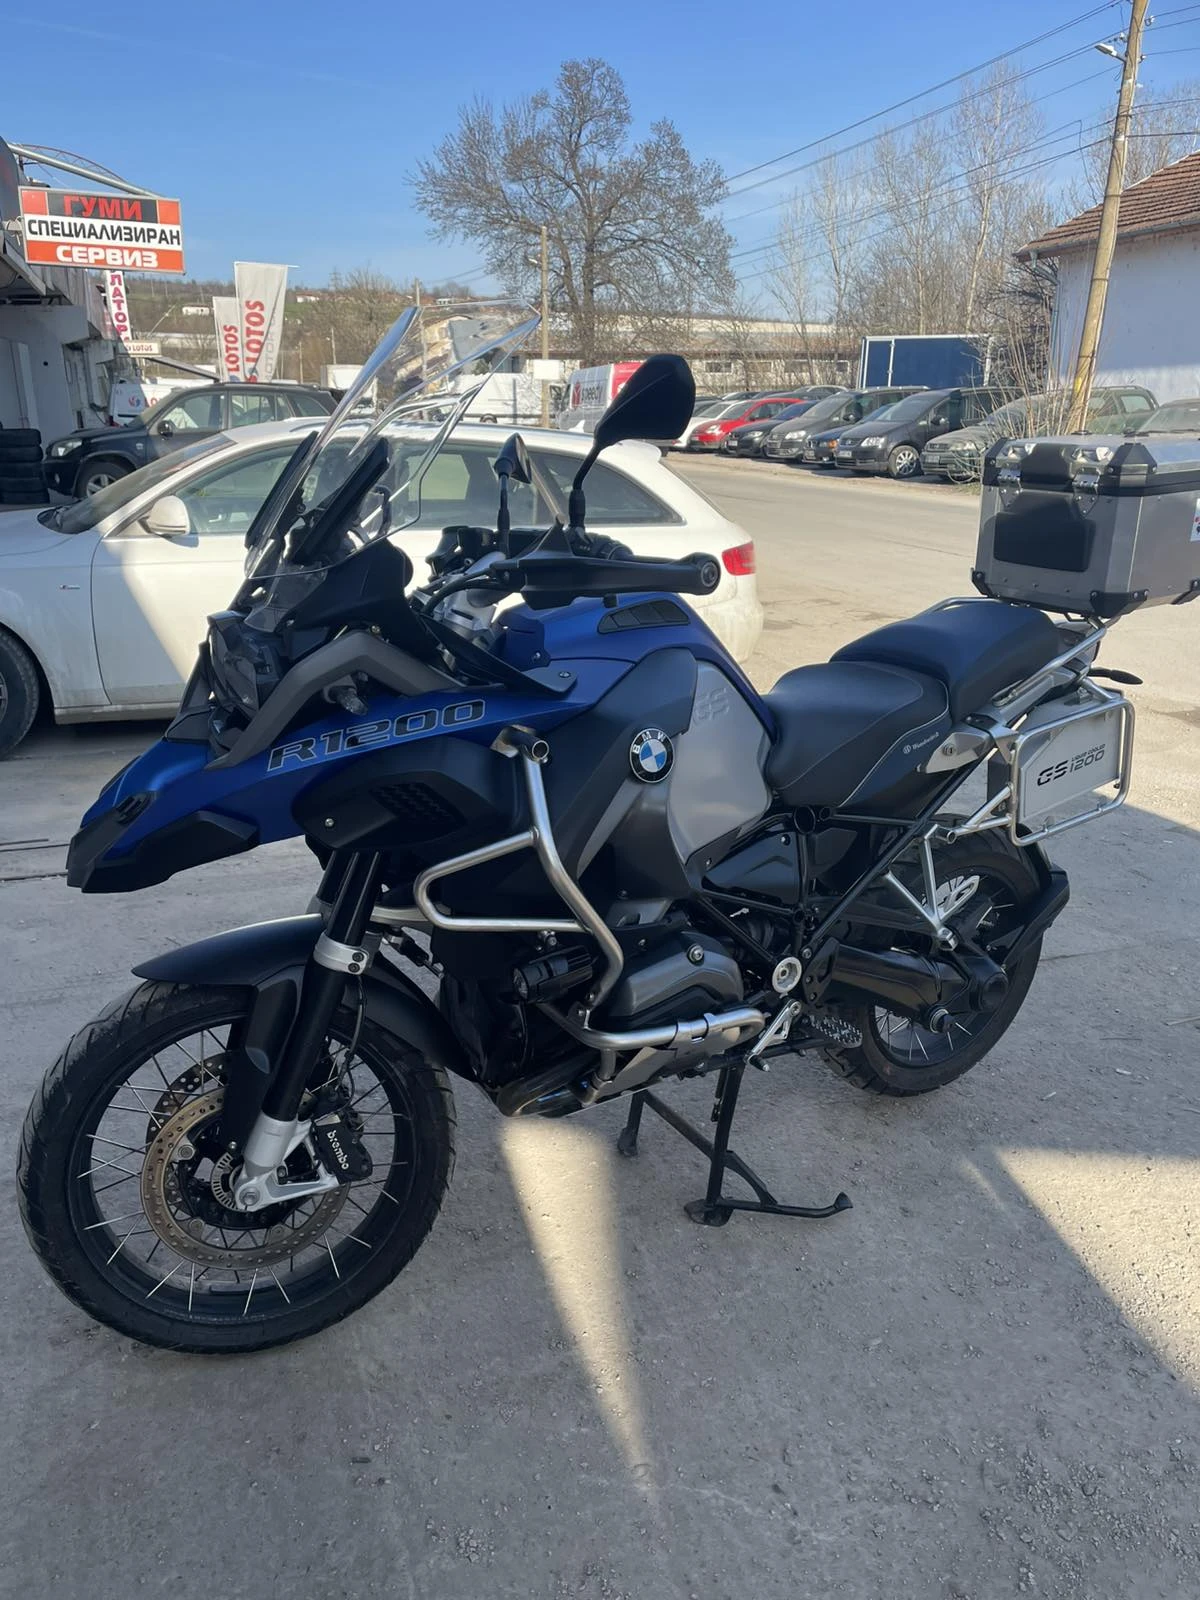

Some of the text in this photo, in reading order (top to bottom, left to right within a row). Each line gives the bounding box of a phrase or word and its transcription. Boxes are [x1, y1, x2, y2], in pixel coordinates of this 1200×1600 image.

[63, 194, 143, 221] ГУМИ
[27, 219, 181, 246] СПЕЦИАЛИЗИРАН
[56, 244, 159, 268] СЕРВИЗ
[223, 324, 240, 372] LOTOS
[266, 698, 486, 772] R1200
[632, 731, 667, 755] BMW
[1036, 749, 1105, 787] GS 1200
[327, 1130, 349, 1170] brembo
